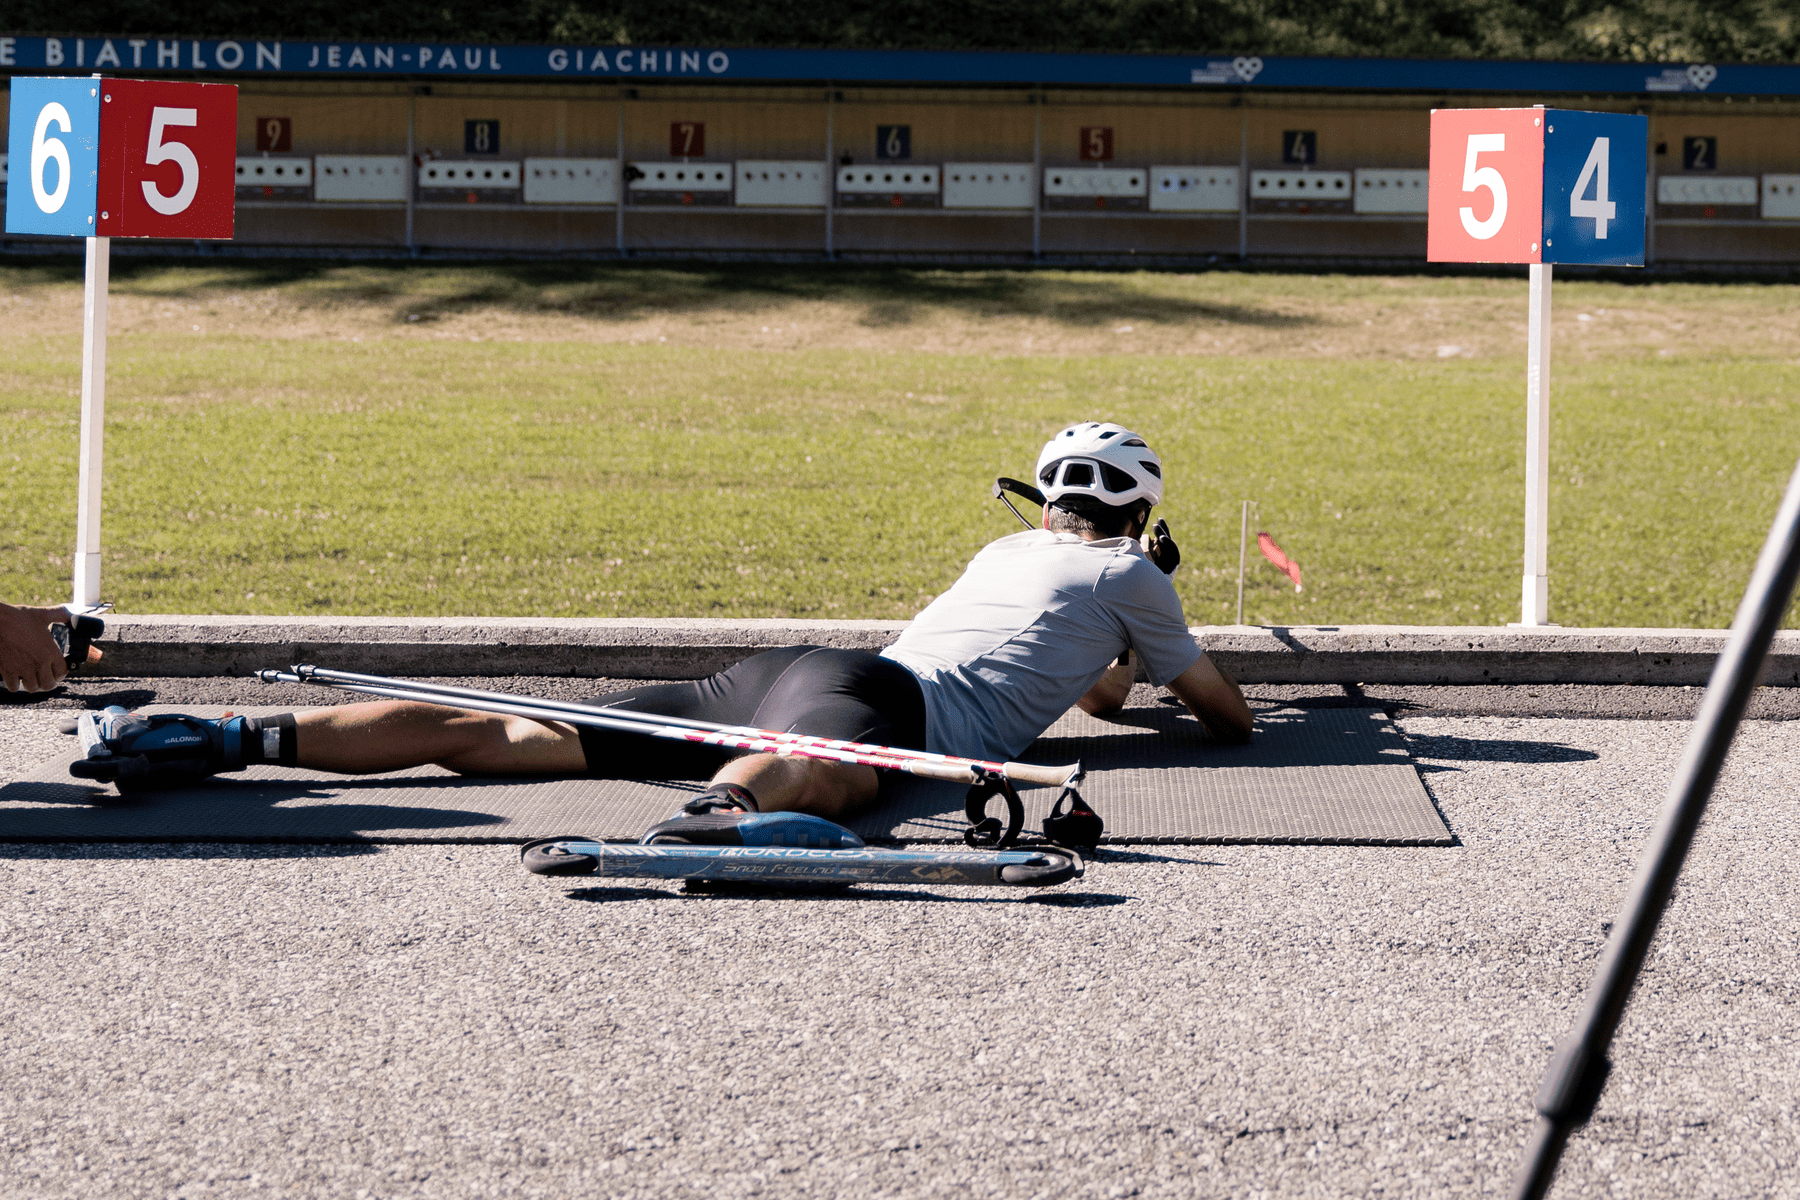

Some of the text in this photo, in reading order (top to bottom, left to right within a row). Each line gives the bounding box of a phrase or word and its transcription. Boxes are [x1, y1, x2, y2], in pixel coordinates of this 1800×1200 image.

[46, 38, 282, 70] BIATHLON
[308, 46, 502, 71] JEAN-PAUL
[548, 49, 730, 74] GIACHINO
[266, 119, 281, 148] 9
[474, 123, 489, 151] 8
[680, 124, 695, 153] 7
[885, 127, 902, 158] 6
[1088, 129, 1104, 158] 5
[1291, 133, 1308, 161] 4
[30, 102, 72, 214] 6
[141, 106, 199, 215] 5
[1692, 139, 1708, 168] 2
[1459, 133, 1508, 240] 5
[1570, 137, 1616, 239] 4
